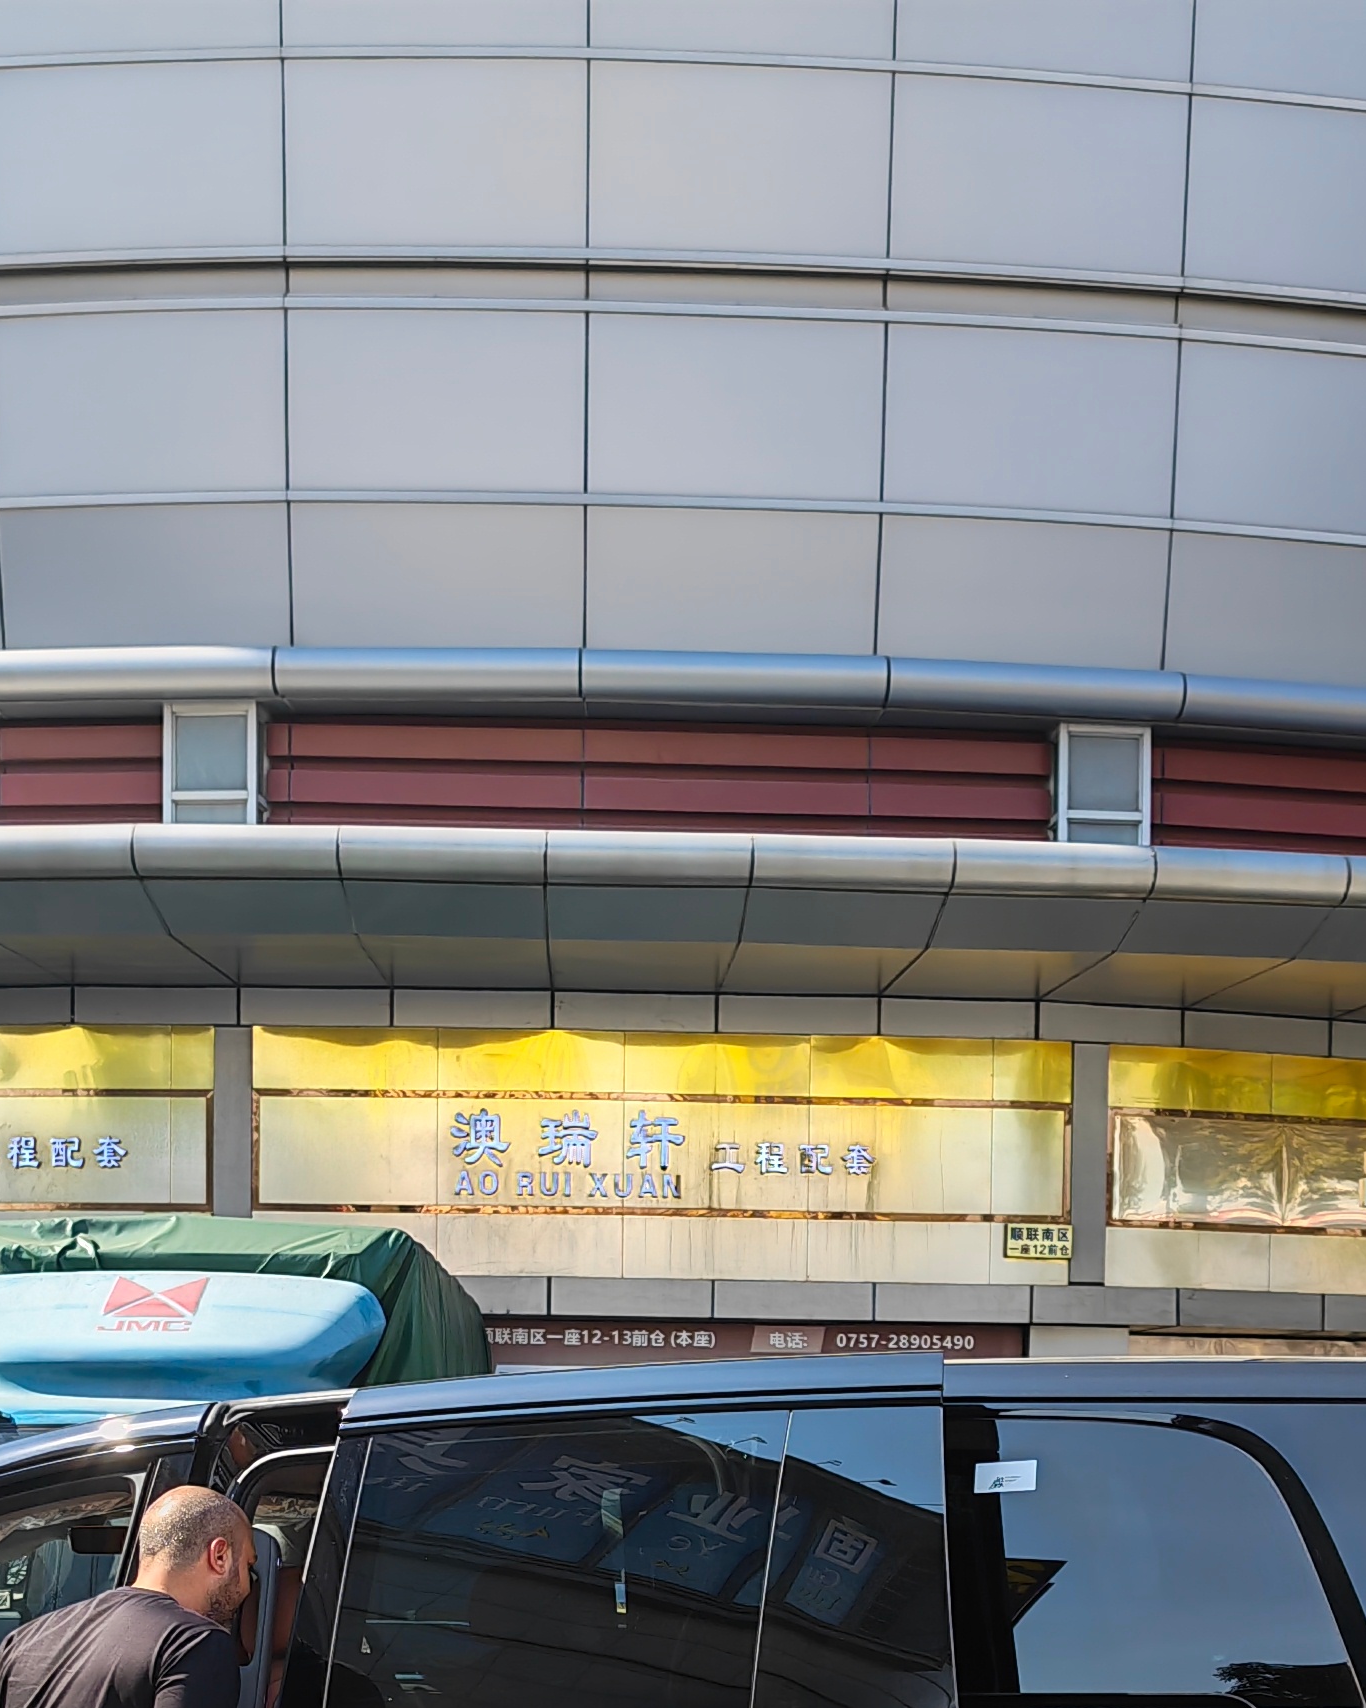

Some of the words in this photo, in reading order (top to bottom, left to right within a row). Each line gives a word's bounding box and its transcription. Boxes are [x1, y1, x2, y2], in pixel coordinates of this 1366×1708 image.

[450, 1108, 686, 1171] 澳瑞轩
[711, 1142, 877, 1176] 工程配套
[453, 1171, 500, 1197] AO
[516, 1171, 572, 1198] RUI
[588, 1173, 682, 1199] XUAN
[1010, 1226, 1070, 1242] 顺联南区
[1008, 1243, 1070, 1256] 一座12前仓
[96, 1320, 193, 1332] JMC
[836, 1333, 975, 1351] 0757-28905490
